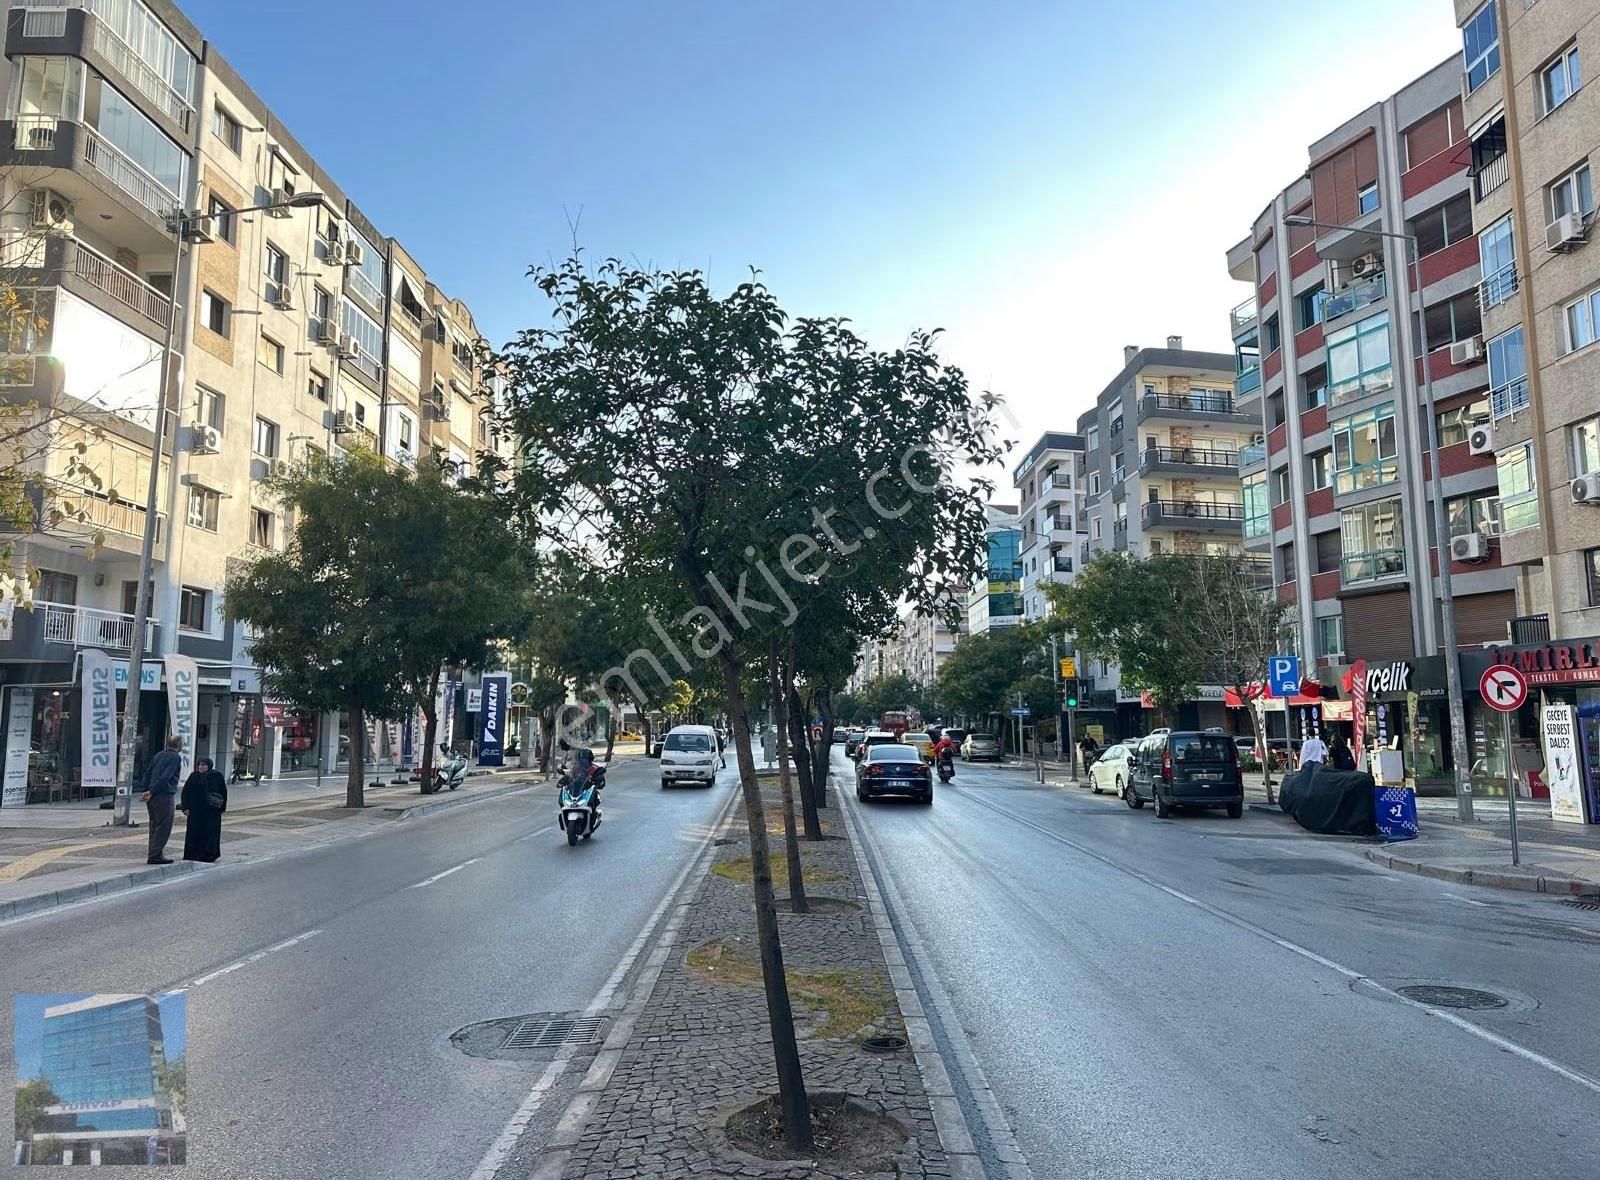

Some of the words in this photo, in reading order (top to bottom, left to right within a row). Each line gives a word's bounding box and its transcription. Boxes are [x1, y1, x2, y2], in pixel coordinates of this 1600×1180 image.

[1275, 659, 1290, 681] P
[1366, 661, 1409, 699] rçelik
[487, 682, 498, 730] DAIKIN
[1546, 710, 1568, 721] GECEYE
[1546, 723, 1570, 735] SERBEST
[1390, 804, 1402, 817] +1
